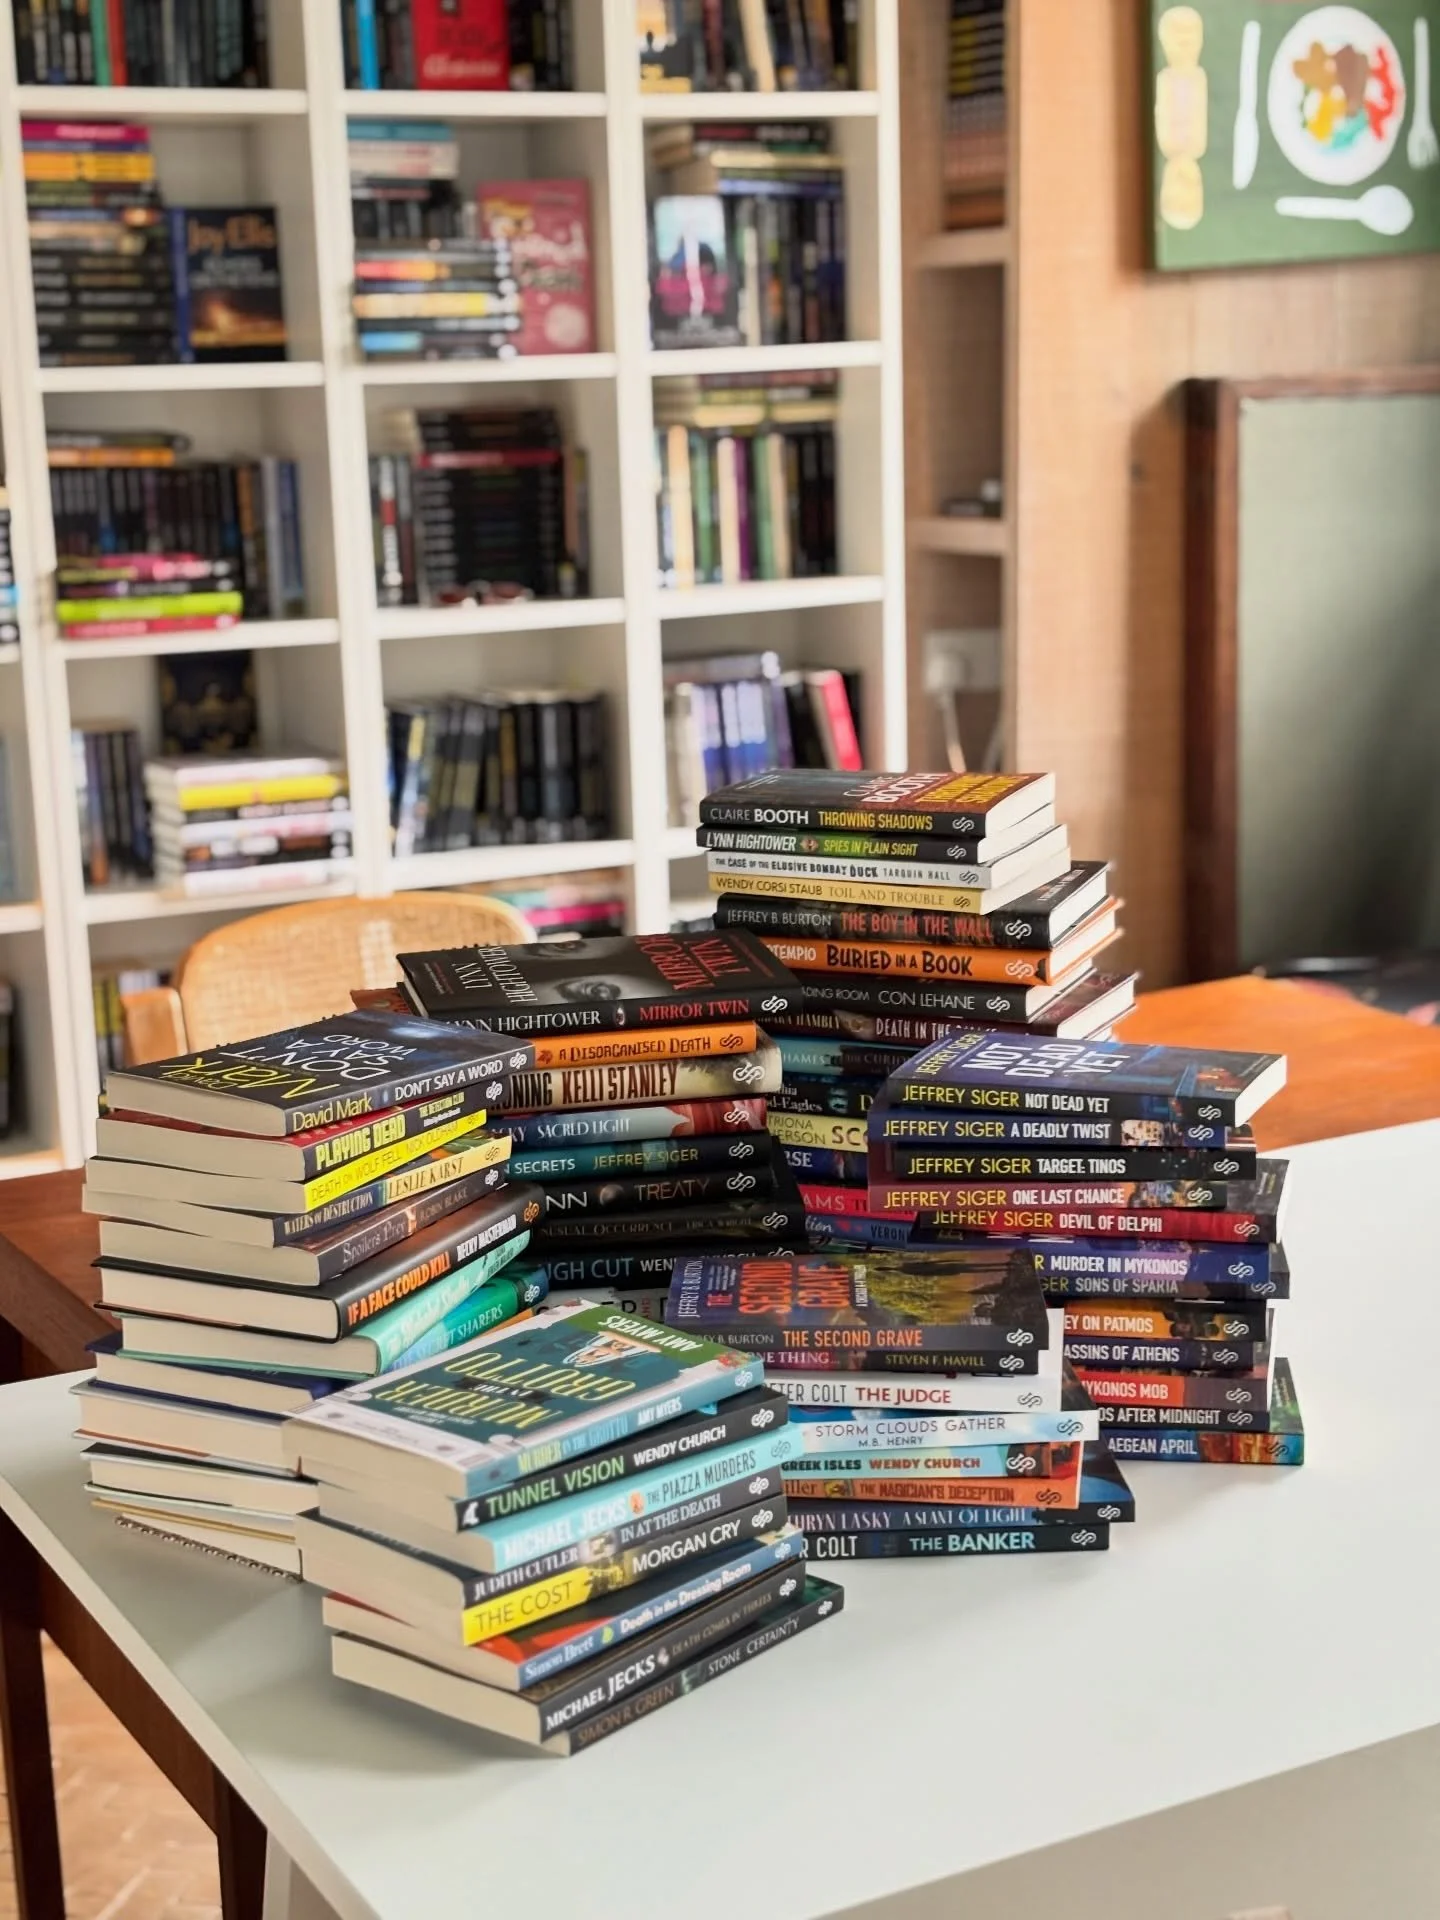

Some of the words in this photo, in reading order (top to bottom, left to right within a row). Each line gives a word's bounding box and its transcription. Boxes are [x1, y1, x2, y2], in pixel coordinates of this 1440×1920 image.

[861, 773, 949, 803] BOOTH
[710, 808, 750, 821] CLAIRE
[754, 809, 809, 825] BOOTH
[818, 811, 876, 828] THROWING
[879, 814, 933, 831] SHADOWS
[706, 832, 734, 848] LYNN
[736, 834, 797, 852] HIGHTOWER
[824, 839, 850, 853] SPIES
[863, 842, 889, 855] PLAIN
[891, 843, 918, 857] SIGHT
[728, 856, 746, 868] CASE
[771, 861, 807, 872] ELUSIVE
[810, 863, 847, 876] BOMBAY
[850, 864, 878, 878] DUCK
[884, 868, 923, 879] TARQUIN
[928, 870, 950, 881] HALL
[717, 877, 754, 890] WENDY
[756, 879, 787, 892] CORSI
[789, 882, 823, 896] STAUB
[891, 891, 944, 905] TROUBLE
[727, 910, 768, 923] JEFFREY
[782, 913, 832, 927] BURTON
[841, 912, 866, 931] THE
[871, 913, 899, 932] BOY
[923, 915, 949, 935] THE
[452, 962, 492, 990] LYNN
[478, 946, 538, 1003] HIGHTOWER
[878, 991, 916, 1006] CON
[920, 993, 976, 1010] LEHANE
[498, 1011, 600, 1032] HIGHTOWER
[639, 1003, 703, 1021] MIRROR
[709, 1000, 749, 1017] TWIN
[876, 1017, 911, 1037] DEATH
[324, 1034, 418, 1057] WORD
[670, 1037, 711, 1055] DEATH
[962, 1042, 1033, 1070] NOT
[1005, 1043, 1086, 1078] DEAD
[1063, 1050, 1131, 1074] YET
[160, 1057, 339, 1099] Mark
[562, 1067, 603, 1104] KELLI
[608, 1062, 678, 1100] STANLEY
[292, 1106, 334, 1131] David
[336, 1095, 372, 1119] Mark
[395, 1081, 431, 1101] DON'T
[434, 1072, 456, 1089] SAY
[468, 1060, 503, 1079] WORD
[902, 1085, 966, 1103] JEFFREY
[971, 1089, 1019, 1107] SIGER
[1025, 1094, 1049, 1109] NOT
[1052, 1095, 1084, 1112] DEAD
[1087, 1097, 1110, 1113] YET
[315, 1123, 372, 1170] PLAYING
[372, 1114, 406, 1151] DEAD
[883, 1120, 949, 1137] JEFFREY
[954, 1121, 1006, 1137] SIGER
[1011, 1123, 1020, 1138] A
[1022, 1122, 1068, 1139] DEADLY
[1070, 1123, 1111, 1139] TWIST
[515, 1158, 576, 1175] SECRETS
[593, 1152, 649, 1170] JEFFREY
[657, 1148, 698, 1163] SIGER
[908, 1158, 975, 1175] JEFFREY
[980, 1158, 1031, 1174] SIGER
[1088, 1158, 1126, 1174] TINOS
[311, 1178, 343, 1202] DEATH
[323, 1191, 373, 1222] DESTRUCTION
[388, 1171, 426, 1201] LESLIE
[429, 1157, 465, 1184] KARST
[634, 1179, 711, 1201] TREATY
[884, 1191, 951, 1209] JEFFREY
[956, 1190, 1008, 1206] SIGER
[1012, 1189, 1039, 1205] ONE
[1041, 1189, 1073, 1204] LAST
[1075, 1188, 1124, 1204] CHANCE
[933, 1210, 998, 1225] JEFFREY
[1004, 1212, 1053, 1228] SIGER
[1060, 1213, 1096, 1230] DEVIL
[1098, 1214, 1115, 1231] OF
[1118, 1215, 1162, 1233] DELPHI
[592, 1258, 634, 1277] CUT
[1051, 1255, 1104, 1273] MURDER
[1108, 1257, 1121, 1273] IN
[1124, 1257, 1188, 1276] MYKONOS
[369, 1285, 396, 1316] FACE
[395, 1261, 431, 1299] COULD
[738, 1261, 792, 1314] SECOND
[798, 1265, 849, 1308] GRAVE
[1075, 1278, 1109, 1293] SONS
[1112, 1278, 1129, 1293] OF
[1132, 1279, 1179, 1294] SPARTA
[598, 1315, 663, 1340] MYERS
[1083, 1316, 1100, 1331] ON
[1103, 1317, 1153, 1333] PATMOS
[657, 1330, 704, 1352] AMY
[728, 1334, 774, 1345] BURTON
[783, 1331, 809, 1347] THE
[814, 1331, 871, 1346] SECOND
[876, 1330, 923, 1346] GRAVE
[885, 1354, 929, 1366] STEVEN
[944, 1355, 986, 1367] HAVILL
[1064, 1345, 1108, 1360] ASSINS
[1112, 1345, 1129, 1360] OF
[1132, 1346, 1180, 1362] ATHENS
[444, 1352, 636, 1400] GROTTO
[812, 1384, 847, 1403] COLT
[855, 1387, 890, 1402] THE
[894, 1389, 951, 1405] JUDGE
[1139, 1383, 1169, 1399] MOB
[375, 1380, 563, 1429] MURDER
[1117, 1408, 1157, 1424] AFTER
[1159, 1408, 1221, 1425] MIDNIGHT
[815, 1424, 869, 1438] STORM
[876, 1420, 938, 1435] CLOUDS
[945, 1418, 1006, 1432] GATHER
[887, 1436, 924, 1446] HENRY
[1108, 1438, 1157, 1453] AEGEAN
[1159, 1439, 1198, 1455] APRIL
[486, 1479, 560, 1518] TUNNEL
[564, 1456, 625, 1492] VISION
[633, 1441, 676, 1467] WENDY
[678, 1425, 727, 1452] CHURCH
[781, 1460, 822, 1472] GREEK
[824, 1459, 862, 1470] ISLES
[869, 1459, 920, 1470] WENDY
[924, 1458, 981, 1469] CHURCH
[949, 1486, 1014, 1502] DECEPTION
[504, 1521, 573, 1564] MICHAEL
[579, 1499, 626, 1535] JECKS
[662, 1471, 700, 1502] PIAZZA
[704, 1450, 757, 1483] MURDERS
[474, 1570, 525, 1600] JUDITH
[525, 1548, 579, 1580] CUTLER
[653, 1508, 679, 1531] THE
[680, 1493, 722, 1519] DEATH
[817, 1535, 858, 1558] COLT
[909, 1537, 944, 1551] THE
[948, 1532, 1035, 1552] BANKER
[474, 1611, 514, 1633] THE
[520, 1580, 573, 1615] COST
[632, 1533, 707, 1574] MORGAN
[709, 1519, 741, 1544] CRY
[708, 1650, 741, 1676] STONE
[746, 1616, 799, 1653] CERTAINTY
[525, 1652, 563, 1680] Simon
[545, 1686, 605, 1731] MICHAEL
[607, 1655, 656, 1700] JECKS
